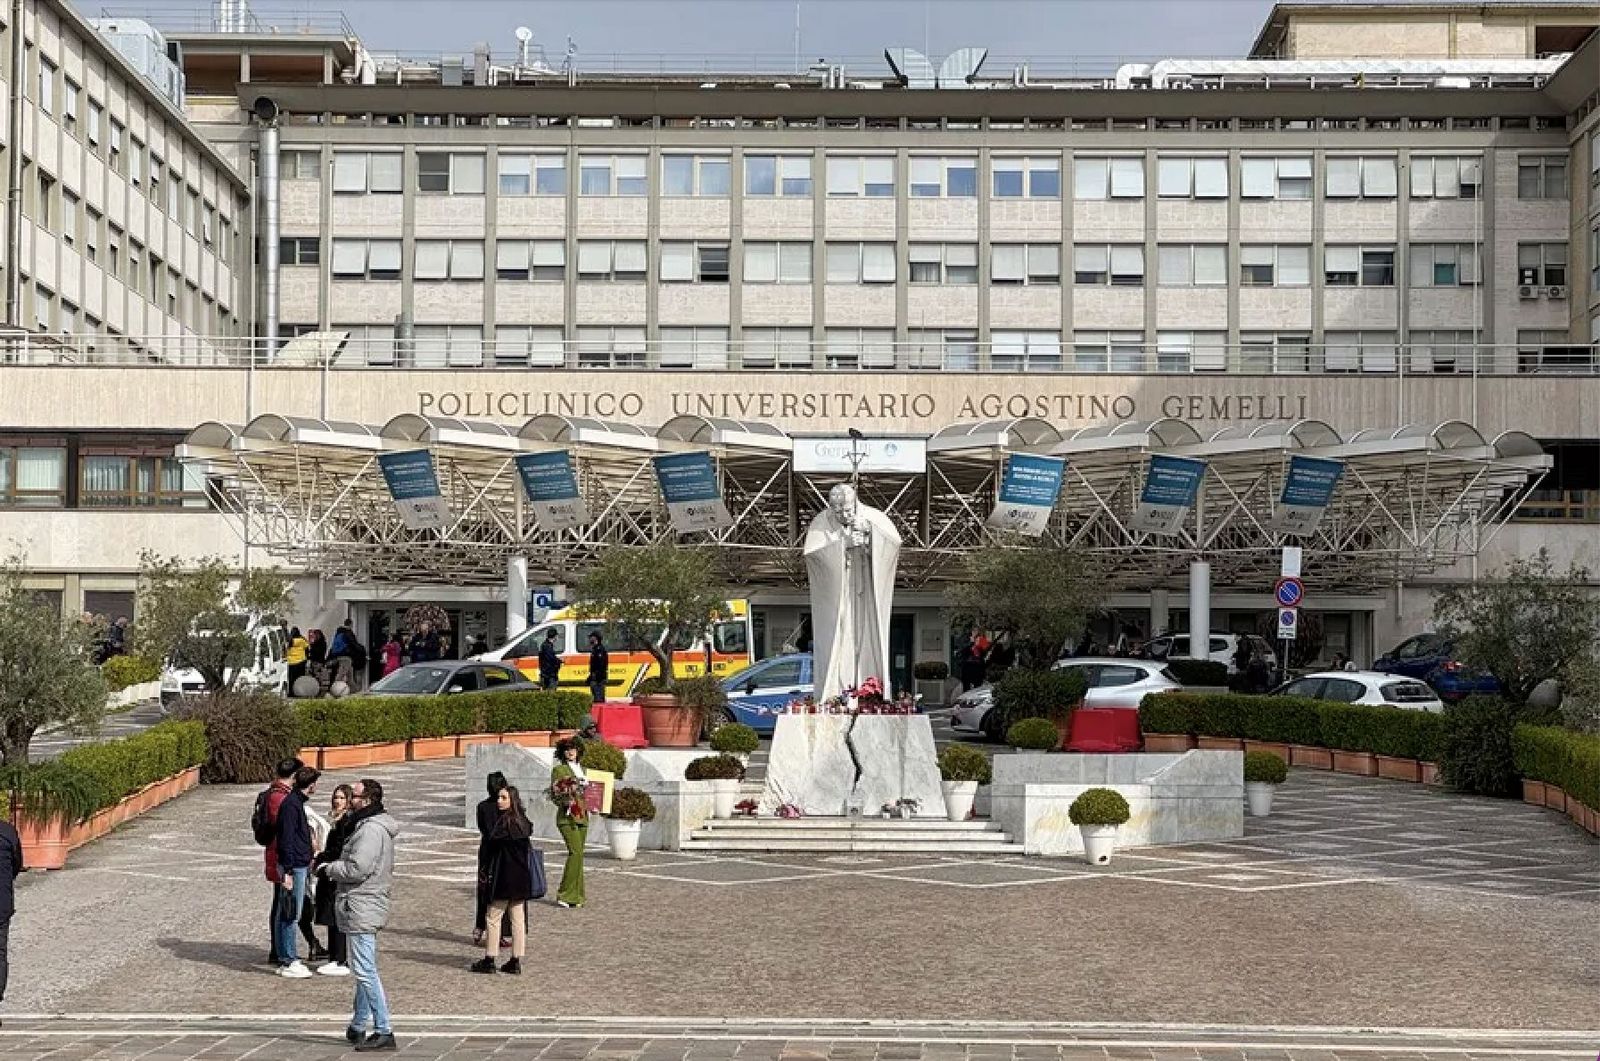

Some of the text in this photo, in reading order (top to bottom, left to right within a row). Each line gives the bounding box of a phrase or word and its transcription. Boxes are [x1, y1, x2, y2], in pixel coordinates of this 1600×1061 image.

[418, 392, 1307, 420] POLICLINICO UNIVERSITARIO AGOSTINO GEMELLI
[814, 441, 871, 458] Gemlli
